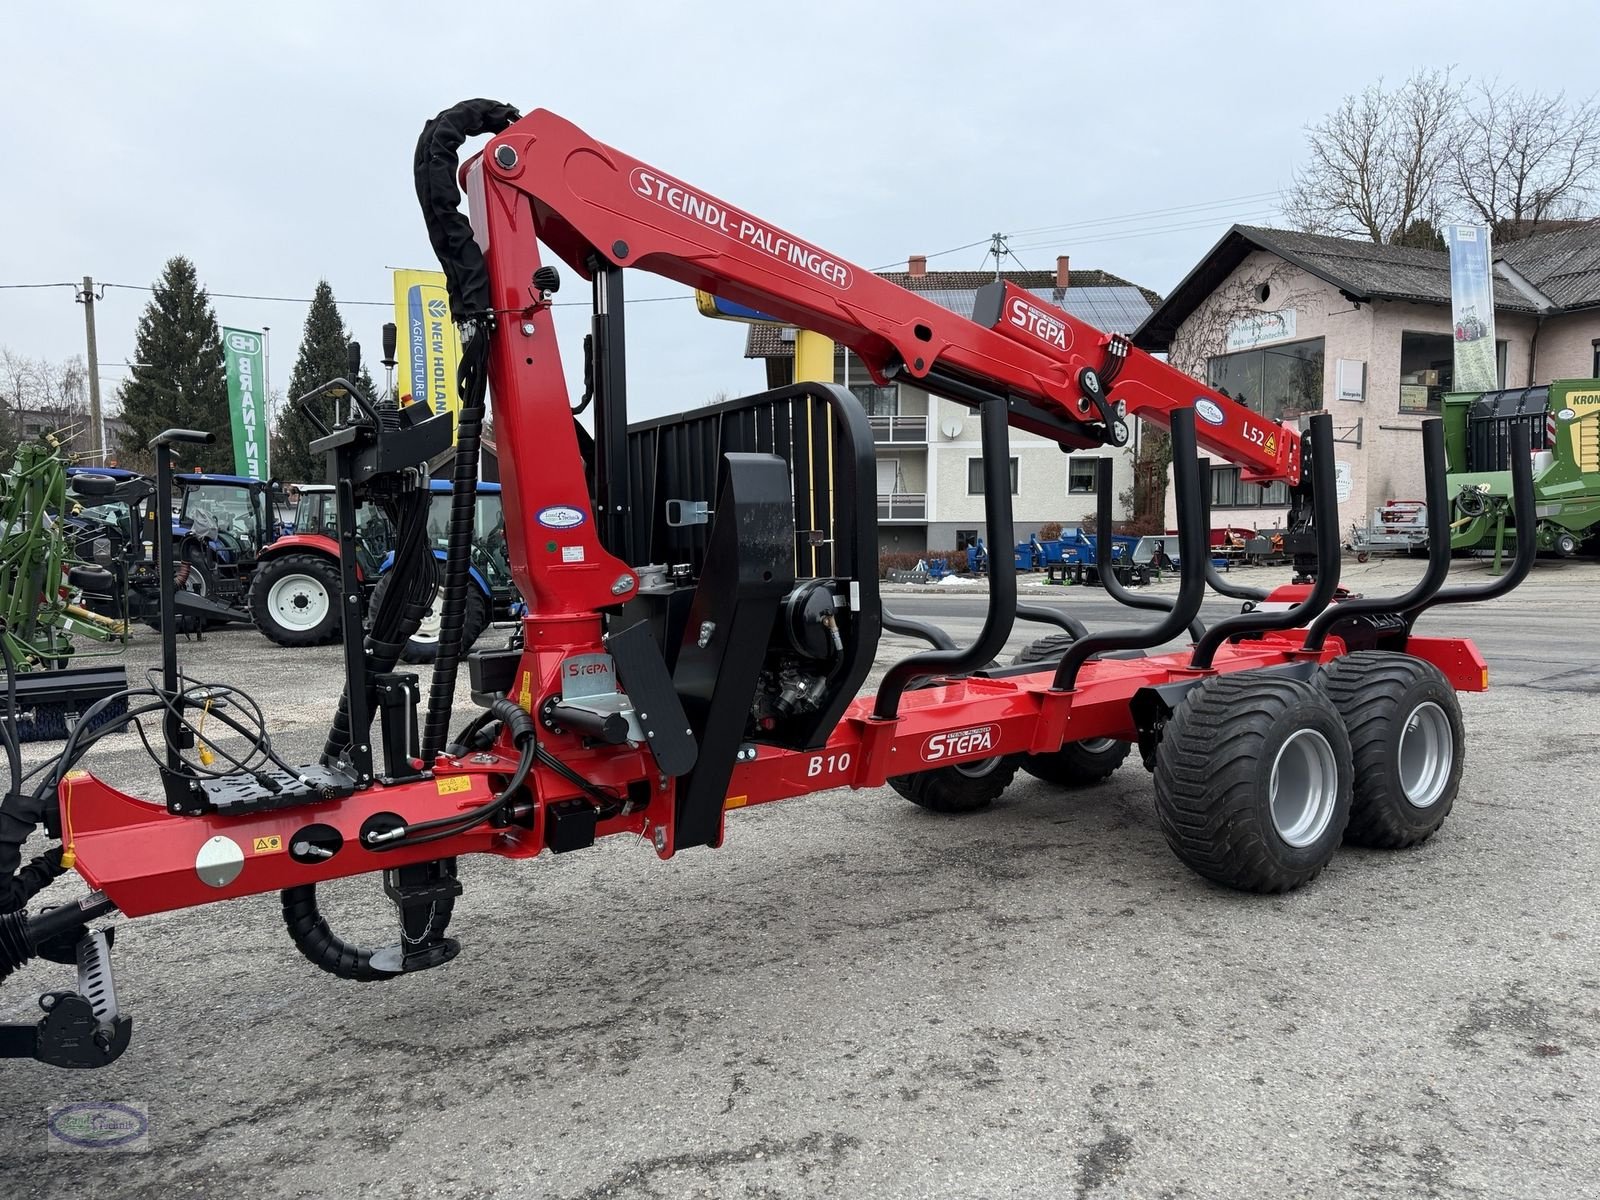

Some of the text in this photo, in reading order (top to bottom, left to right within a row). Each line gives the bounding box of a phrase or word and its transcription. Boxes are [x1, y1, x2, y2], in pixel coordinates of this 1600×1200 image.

[637, 172, 847, 286] STEINDL-PALFINGER
[1011, 300, 1066, 349] STEPA
[412, 318, 425, 398] AGRICULTURE
[431, 321, 447, 416] NEW HOLLAN
[569, 663, 608, 677] STEPA
[927, 732, 992, 760] STEPA
